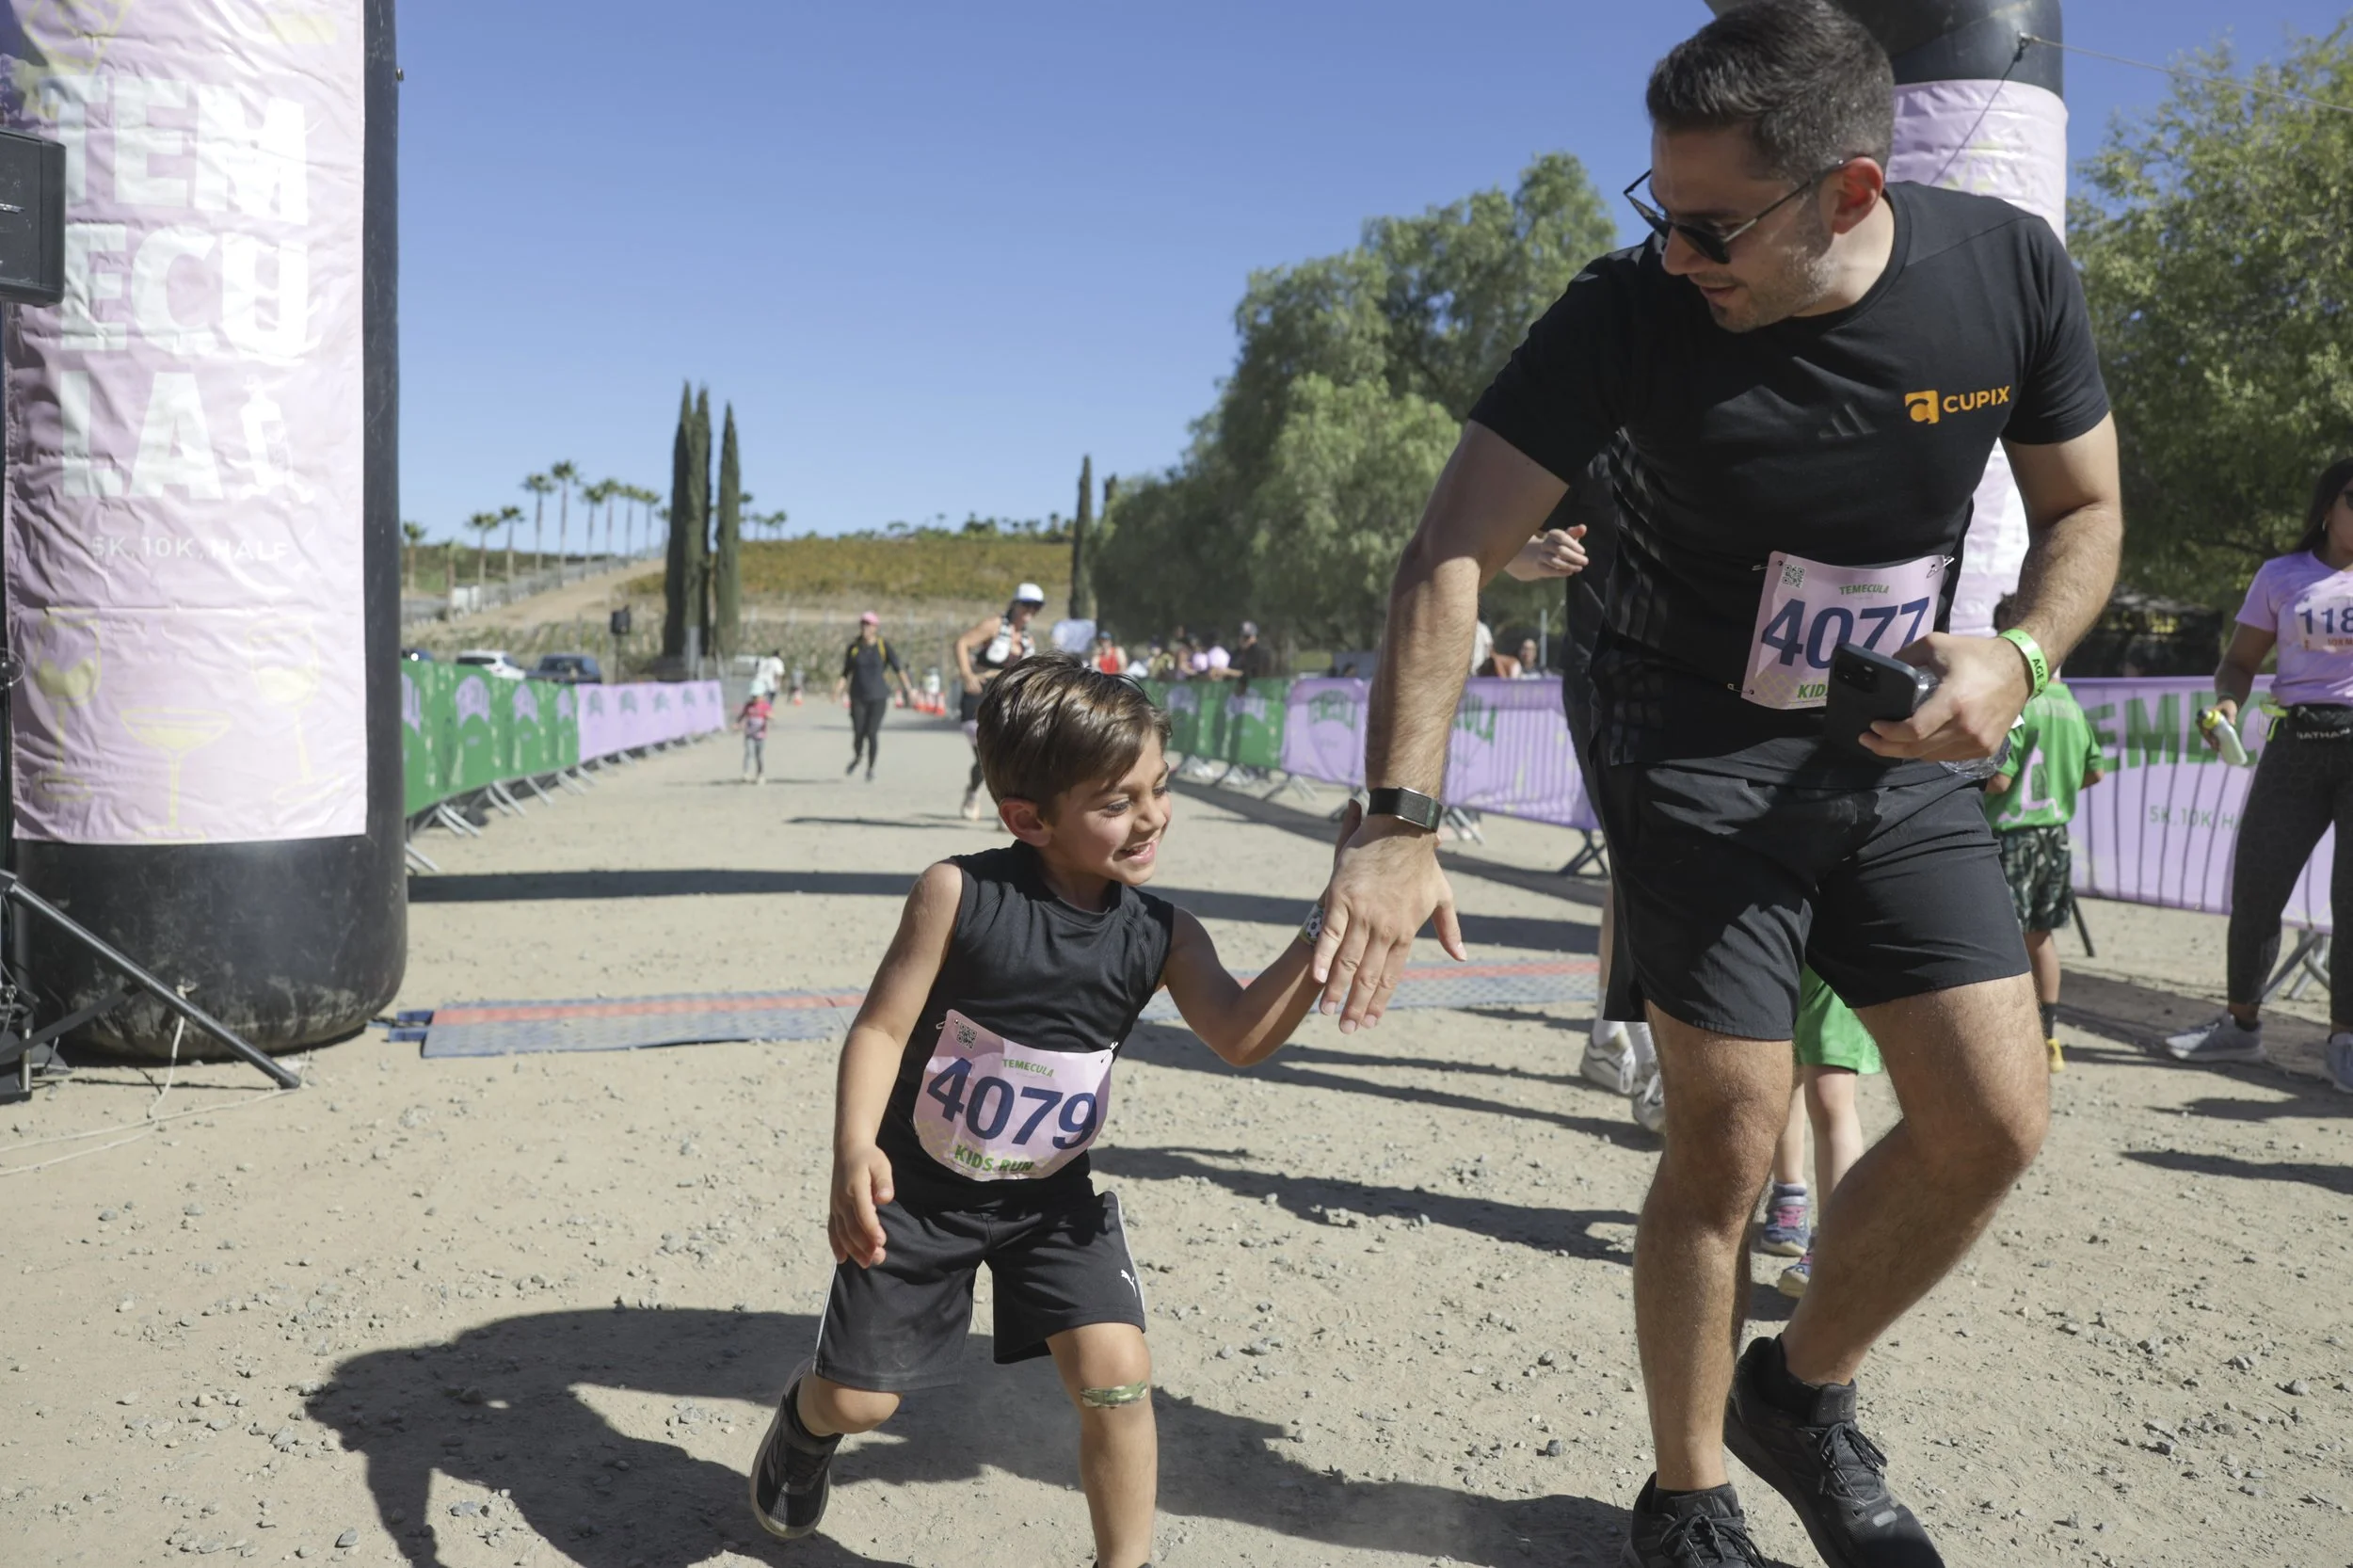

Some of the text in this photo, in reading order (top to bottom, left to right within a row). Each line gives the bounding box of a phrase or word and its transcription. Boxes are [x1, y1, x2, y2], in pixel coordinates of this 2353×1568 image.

[39, 74, 308, 226] TEM
[61, 223, 308, 365] ECU
[1943, 385, 2010, 413] CUPIX
[60, 371, 224, 500] LA
[209, 538, 288, 561] HALF
[1839, 584, 1890, 596] TEMECULA
[1761, 597, 1930, 670] 4077
[2032, 658, 2045, 680] AGE
[1797, 683, 1829, 698] KID
[1001, 1058, 1054, 1078] TEMECULA
[926, 1057, 1098, 1150] 4079
[954, 1144, 1034, 1172] KIDS RUN
